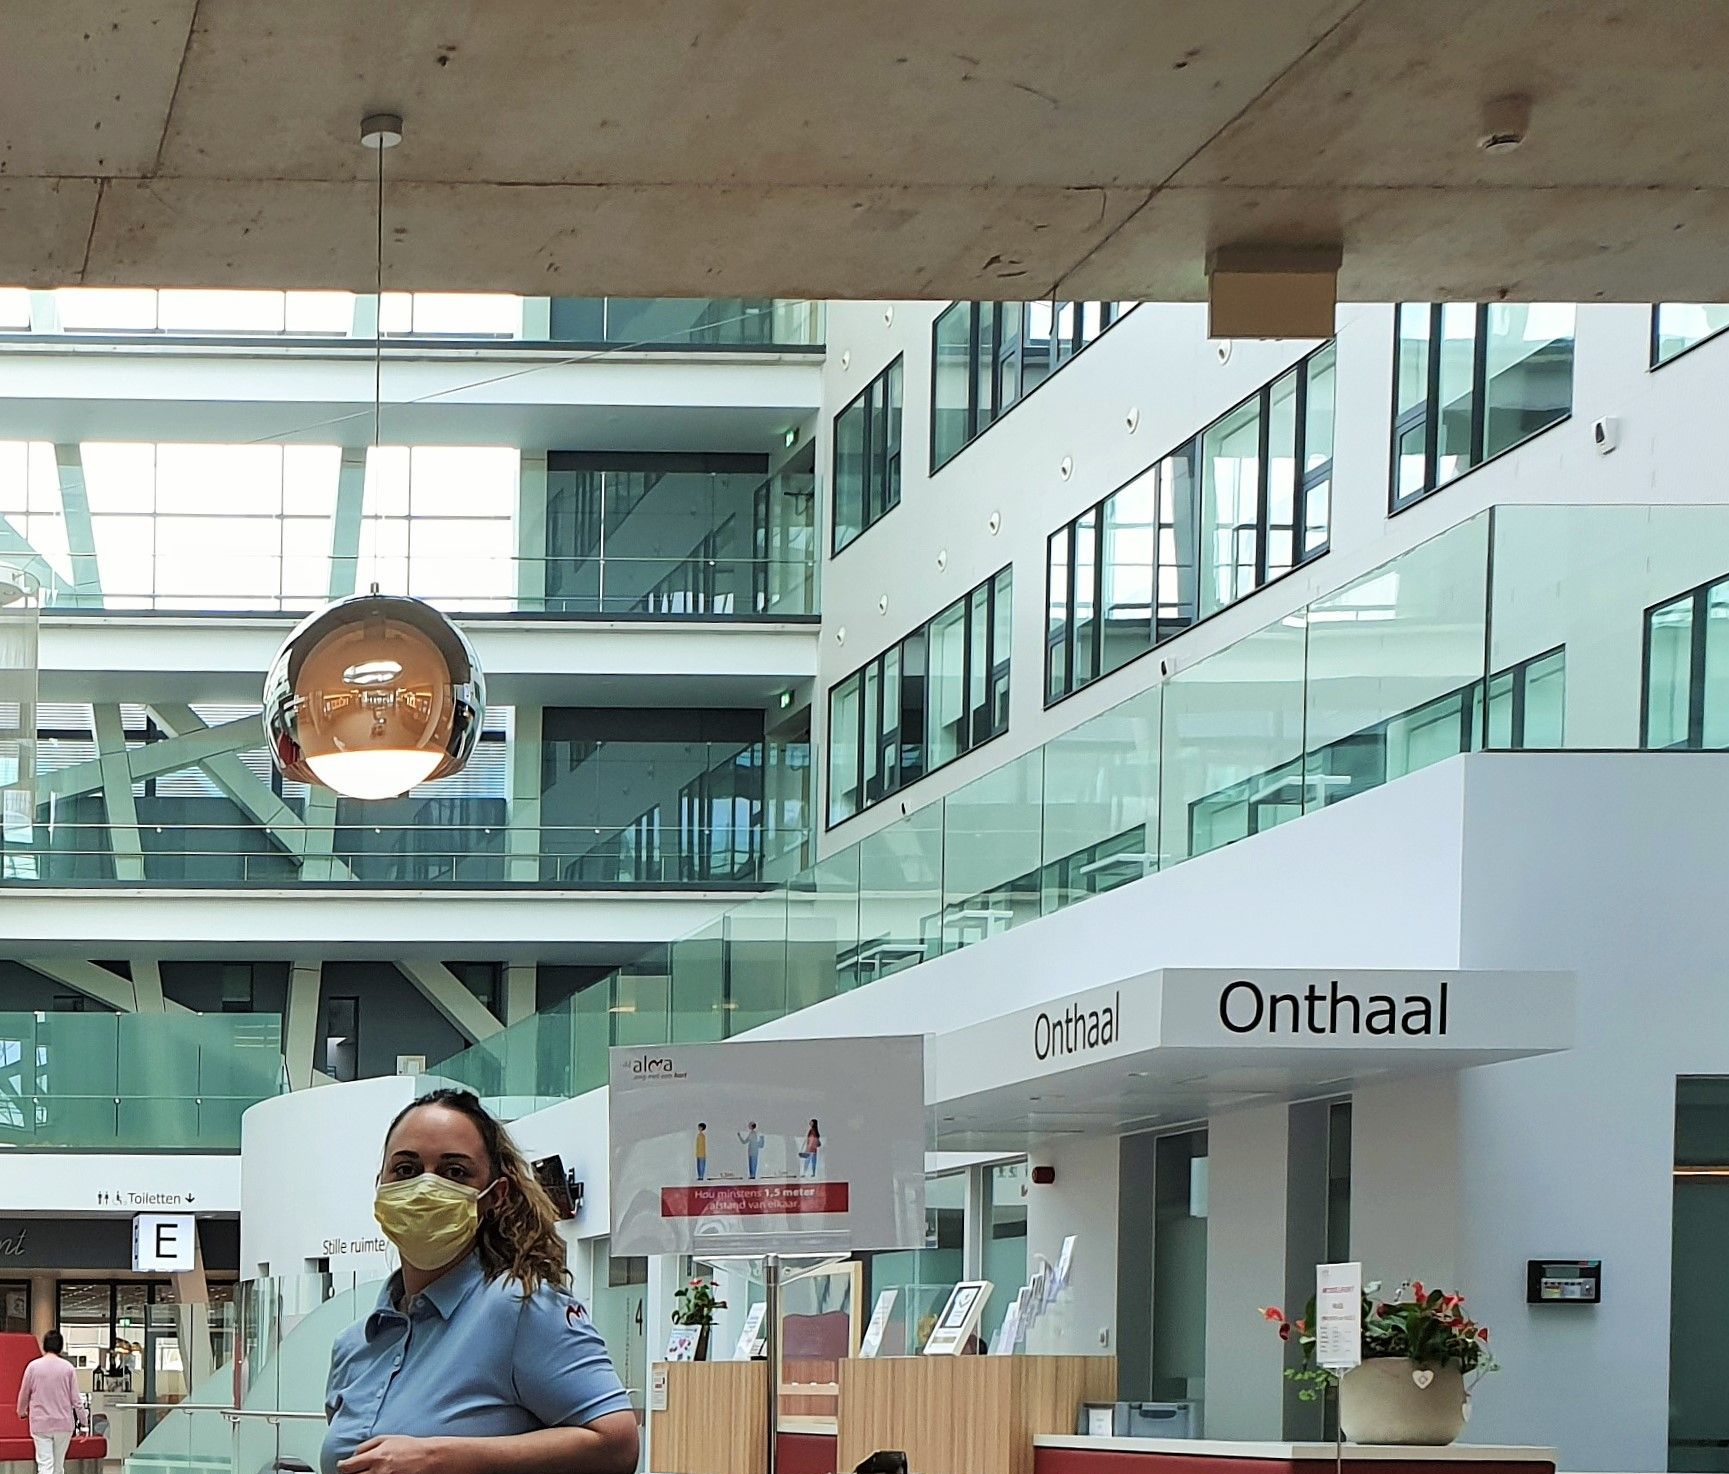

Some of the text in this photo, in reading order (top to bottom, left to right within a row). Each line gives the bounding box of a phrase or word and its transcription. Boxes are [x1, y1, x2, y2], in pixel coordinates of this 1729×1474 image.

[1218, 980, 1448, 1035] Onthaal
[1034, 990, 1120, 1061] Onthaal
[127, 1192, 181, 1204] Toiletten
[694, 1187, 816, 1199] Hou minstens 1,5 meter
[709, 1200, 746, 1210] afstand
[748, 1202, 766, 1210] van
[155, 1223, 178, 1259] E
[322, 1236, 386, 1256] Stille ruimte
